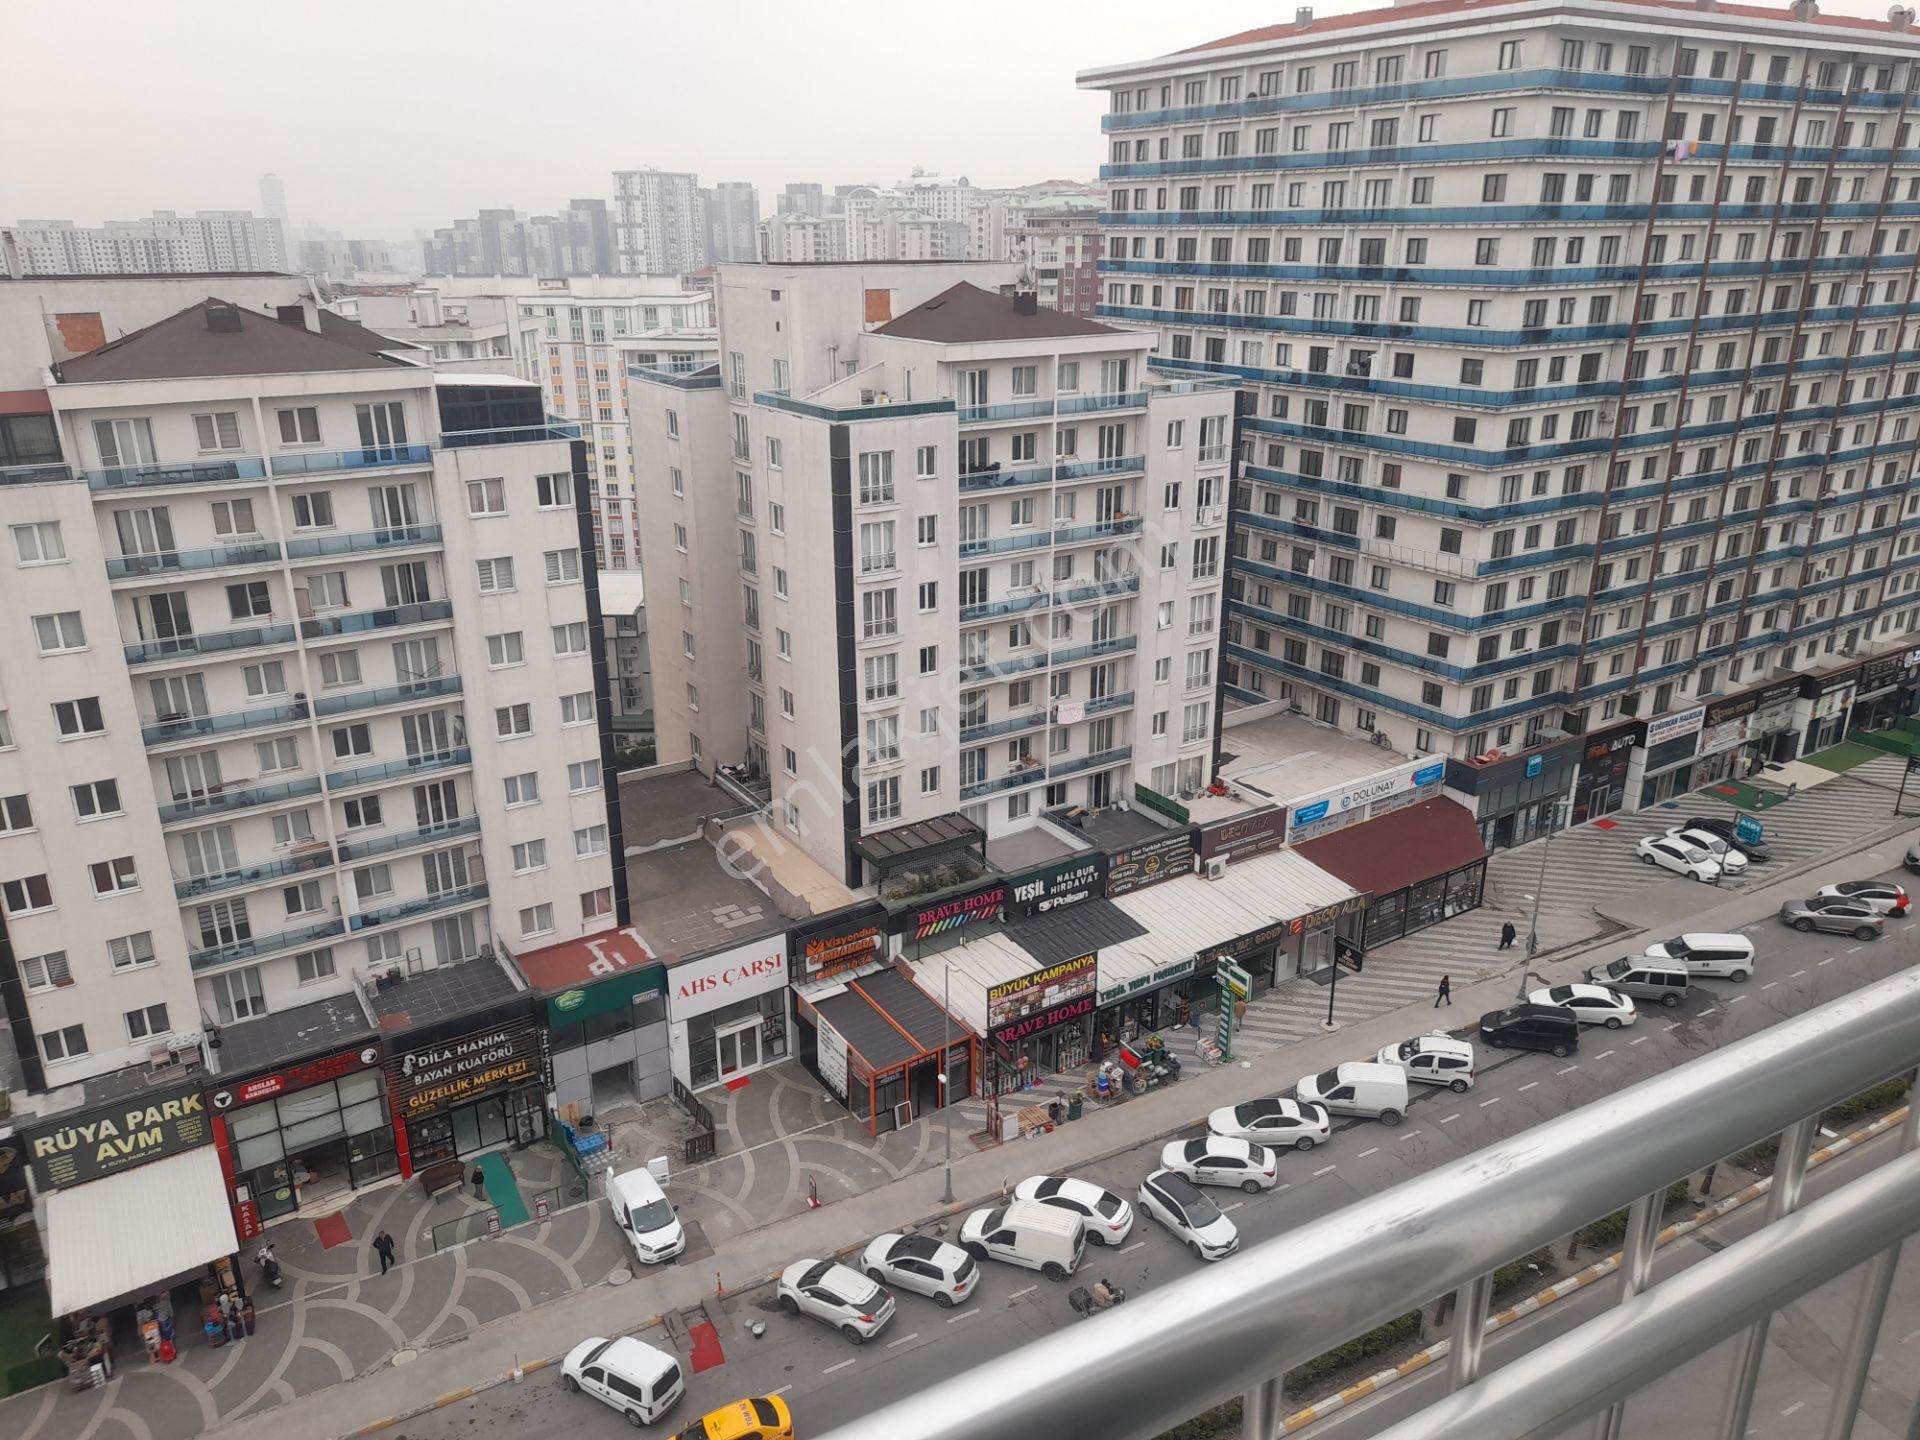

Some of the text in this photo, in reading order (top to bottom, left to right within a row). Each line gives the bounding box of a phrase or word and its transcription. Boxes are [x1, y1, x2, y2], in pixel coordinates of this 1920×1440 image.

[1610, 734, 1636, 751] AUTO
[1353, 779, 1395, 801] DOLUNAY
[1014, 879, 1045, 902] YEŞİL
[1050, 872, 1099, 895] HIRDAVAT
[1057, 865, 1095, 883] NALBUR
[918, 889, 1004, 924] BRAVE HOME
[1053, 890, 1088, 907] Polisan
[677, 953, 782, 1000] AHS ÇARŞI
[990, 976, 1030, 1000] BÜYÜK
[1033, 955, 1095, 984] KAMPANYA
[995, 998, 1093, 1042] BRAVE HOME
[415, 1065, 452, 1085] BAYAN
[457, 1043, 513, 1072] KUAFÖRÜ
[418, 1033, 506, 1067] DİLA HANIM
[409, 1080, 469, 1107] GÜZELLİK
[474, 1059, 526, 1086] MERKEZİ
[34, 1119, 119, 1158] RÜYA
[126, 1093, 203, 1131] PARK
[96, 1127, 163, 1162] AVM
